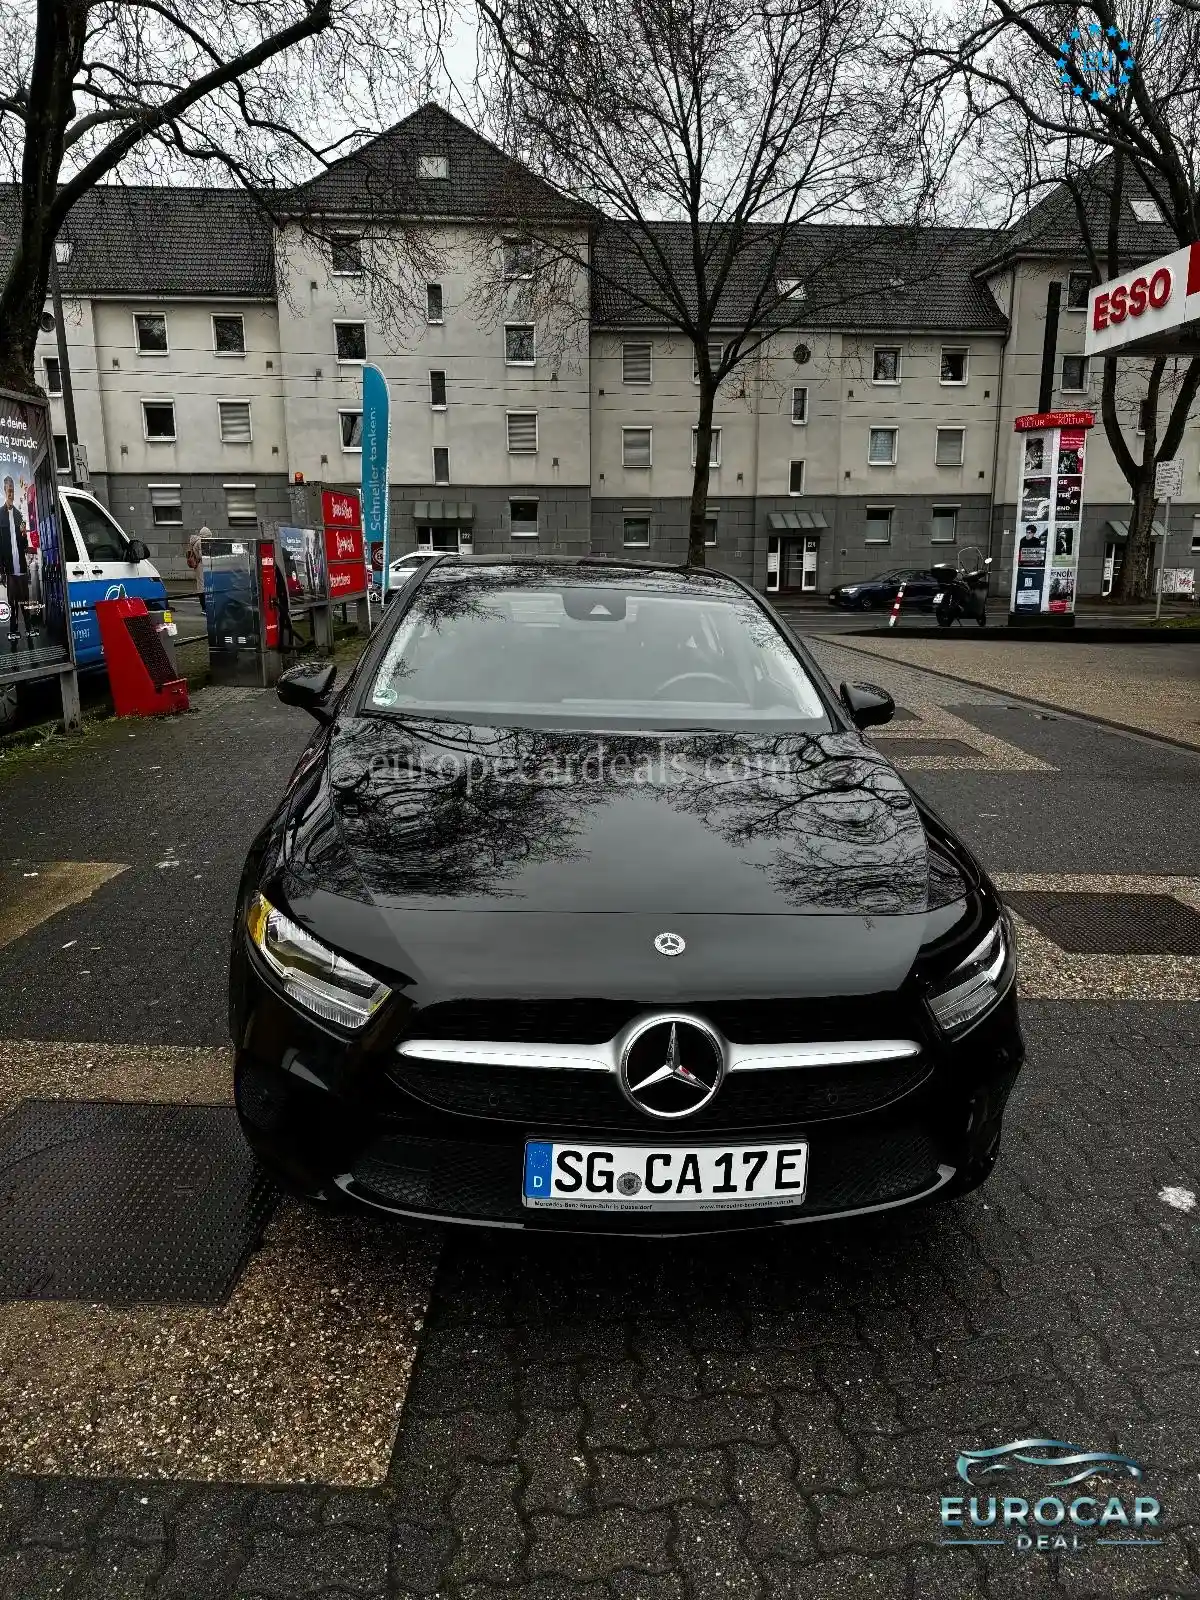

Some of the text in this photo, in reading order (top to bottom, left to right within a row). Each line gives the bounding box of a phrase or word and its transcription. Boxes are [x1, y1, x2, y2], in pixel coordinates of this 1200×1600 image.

[1093, 267, 1172, 332] ESSO
[7, 415, 27, 430] deine
[1058, 417, 1085, 425] KULTUR
[12, 451, 28, 468] Pay.
[368, 407, 381, 531] Schneller tanken:
[555, 1150, 614, 1193] SG
[533, 1176, 543, 1188] D
